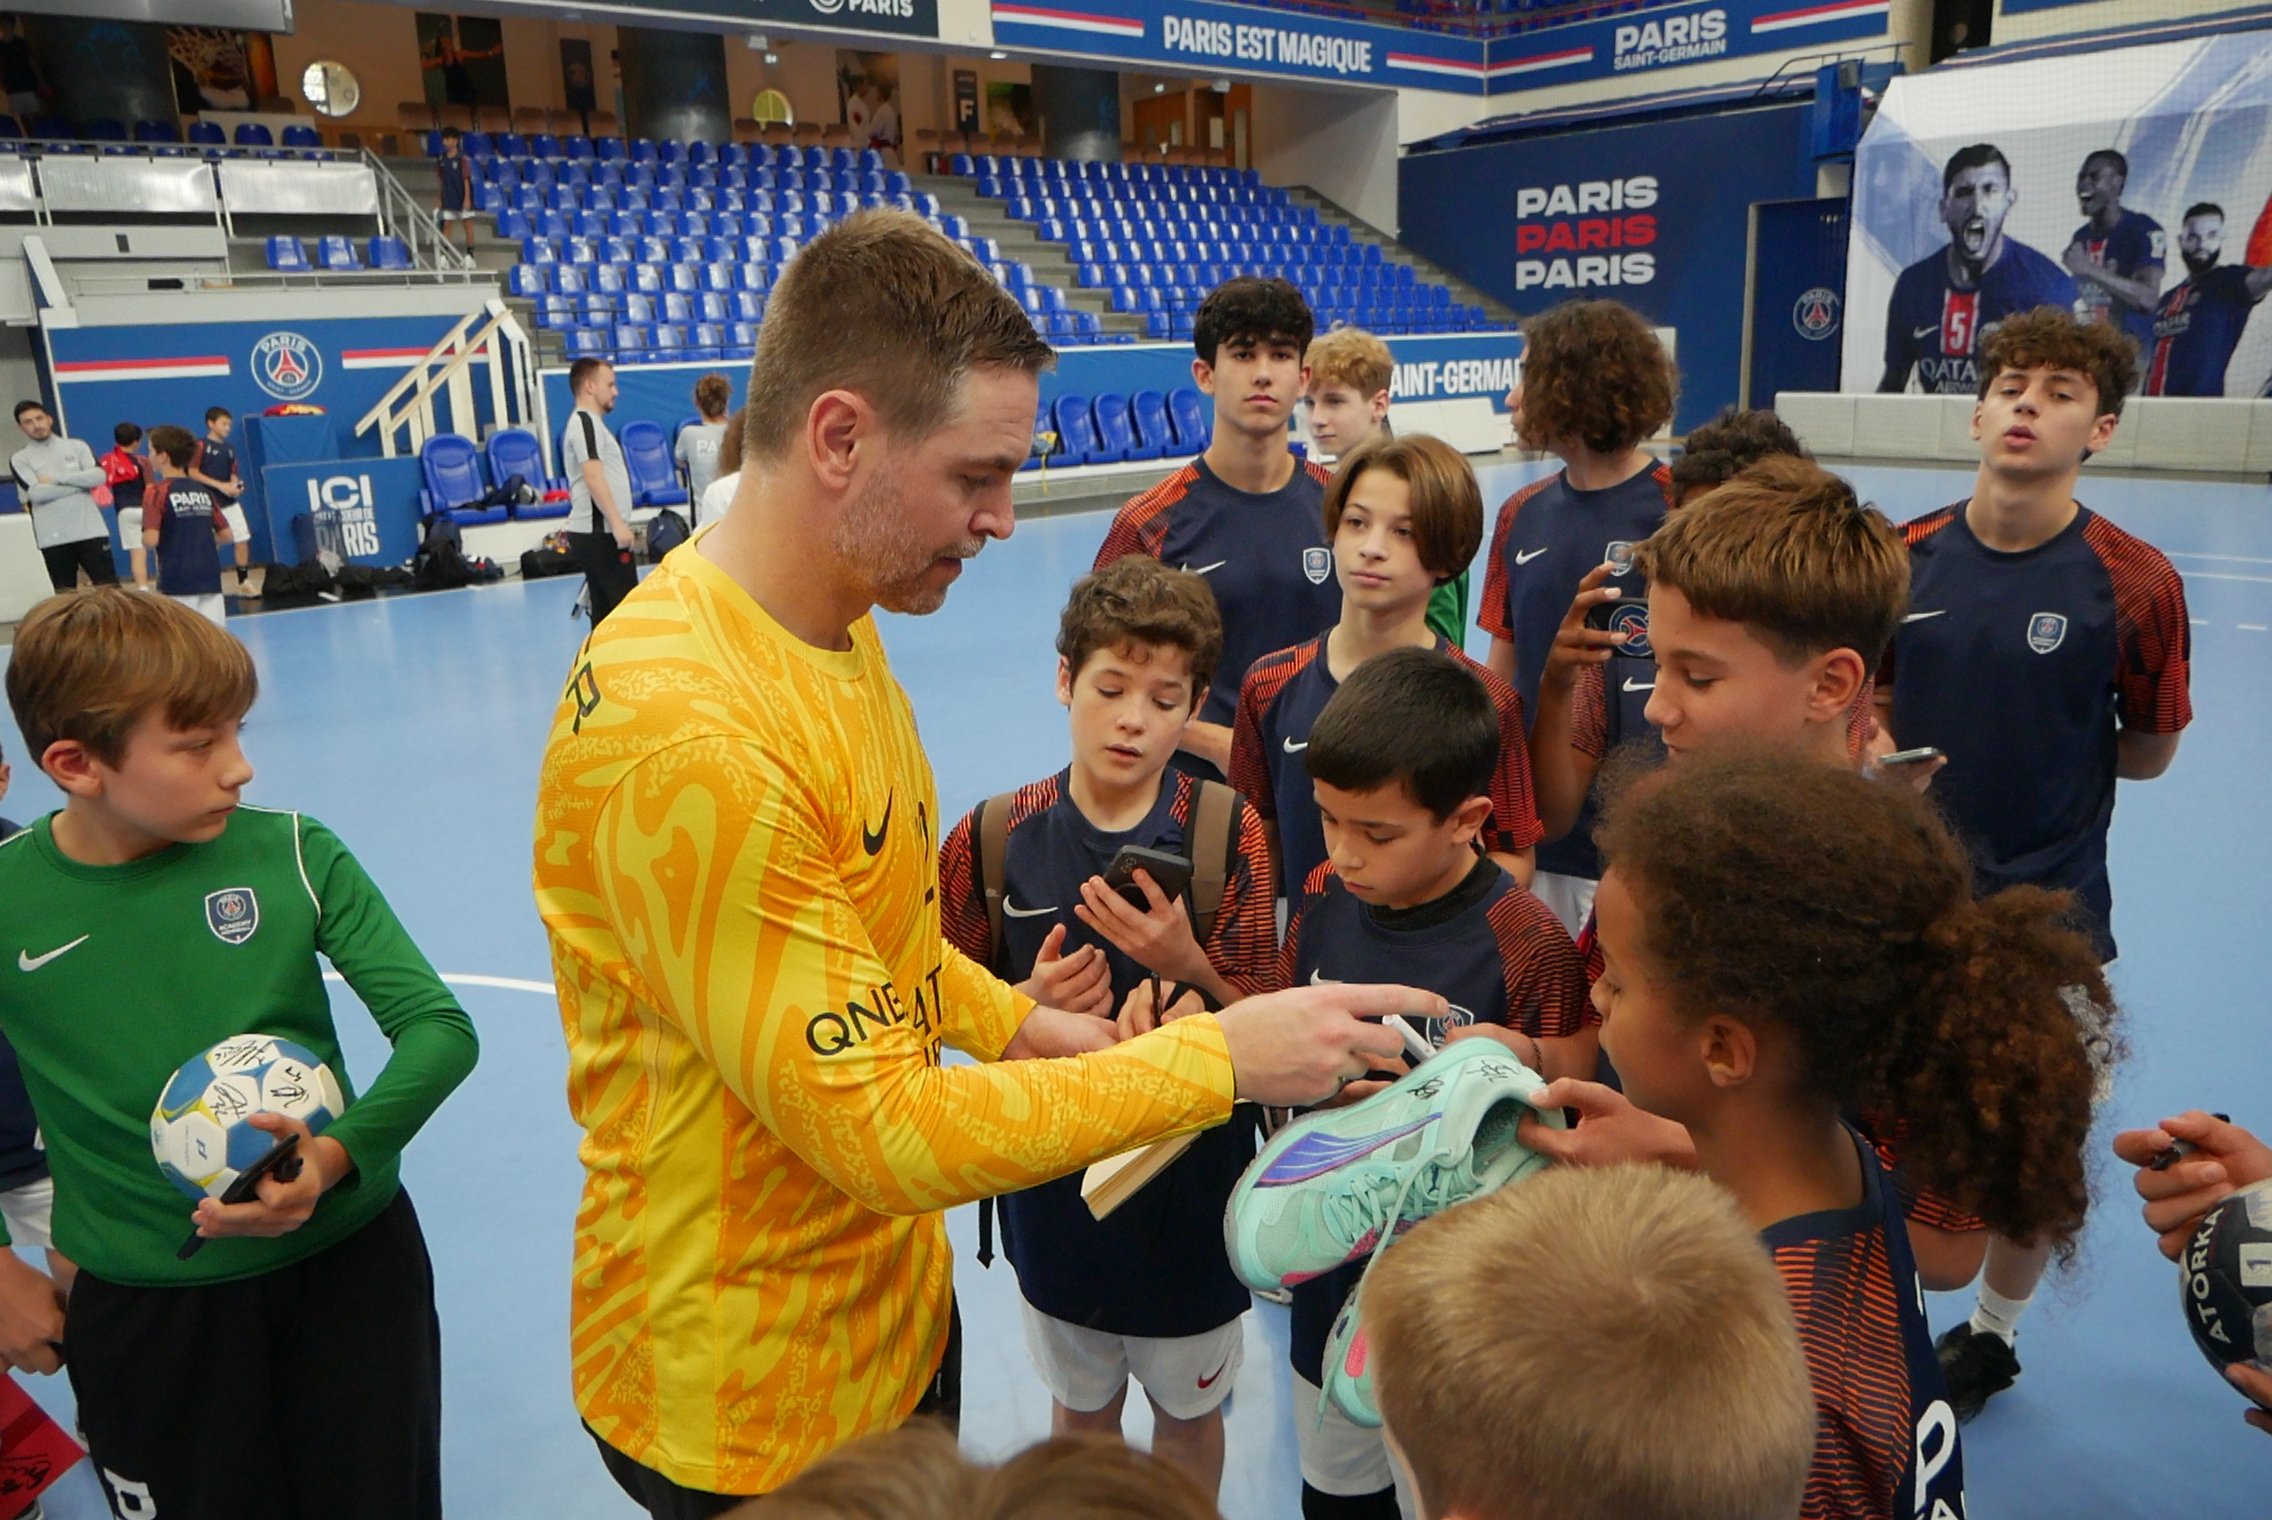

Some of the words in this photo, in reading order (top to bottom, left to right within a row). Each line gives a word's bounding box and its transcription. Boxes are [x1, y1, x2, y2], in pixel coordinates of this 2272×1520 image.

[1163, 15, 1233, 57] PARIS
[1236, 25, 1276, 61] EST
[1278, 30, 1373, 74] MAGIQUE
[1615, 9, 1727, 55] PARIS
[1614, 38, 1726, 70] SAINT-GERMAIN
[960, 99, 974, 122] F
[1516, 176, 1659, 219] PARIS
[1516, 214, 1658, 254] PARIS
[1515, 252, 1656, 290] PARIS
[1950, 312, 1967, 349] 5
[1389, 358, 1524, 398] AINT-GERMAI
[1920, 357, 1980, 382] QATA
[169, 491, 212, 510] PARIS
[307, 474, 373, 512] ICI
[2190, 1207, 2231, 1344] ATORKA
